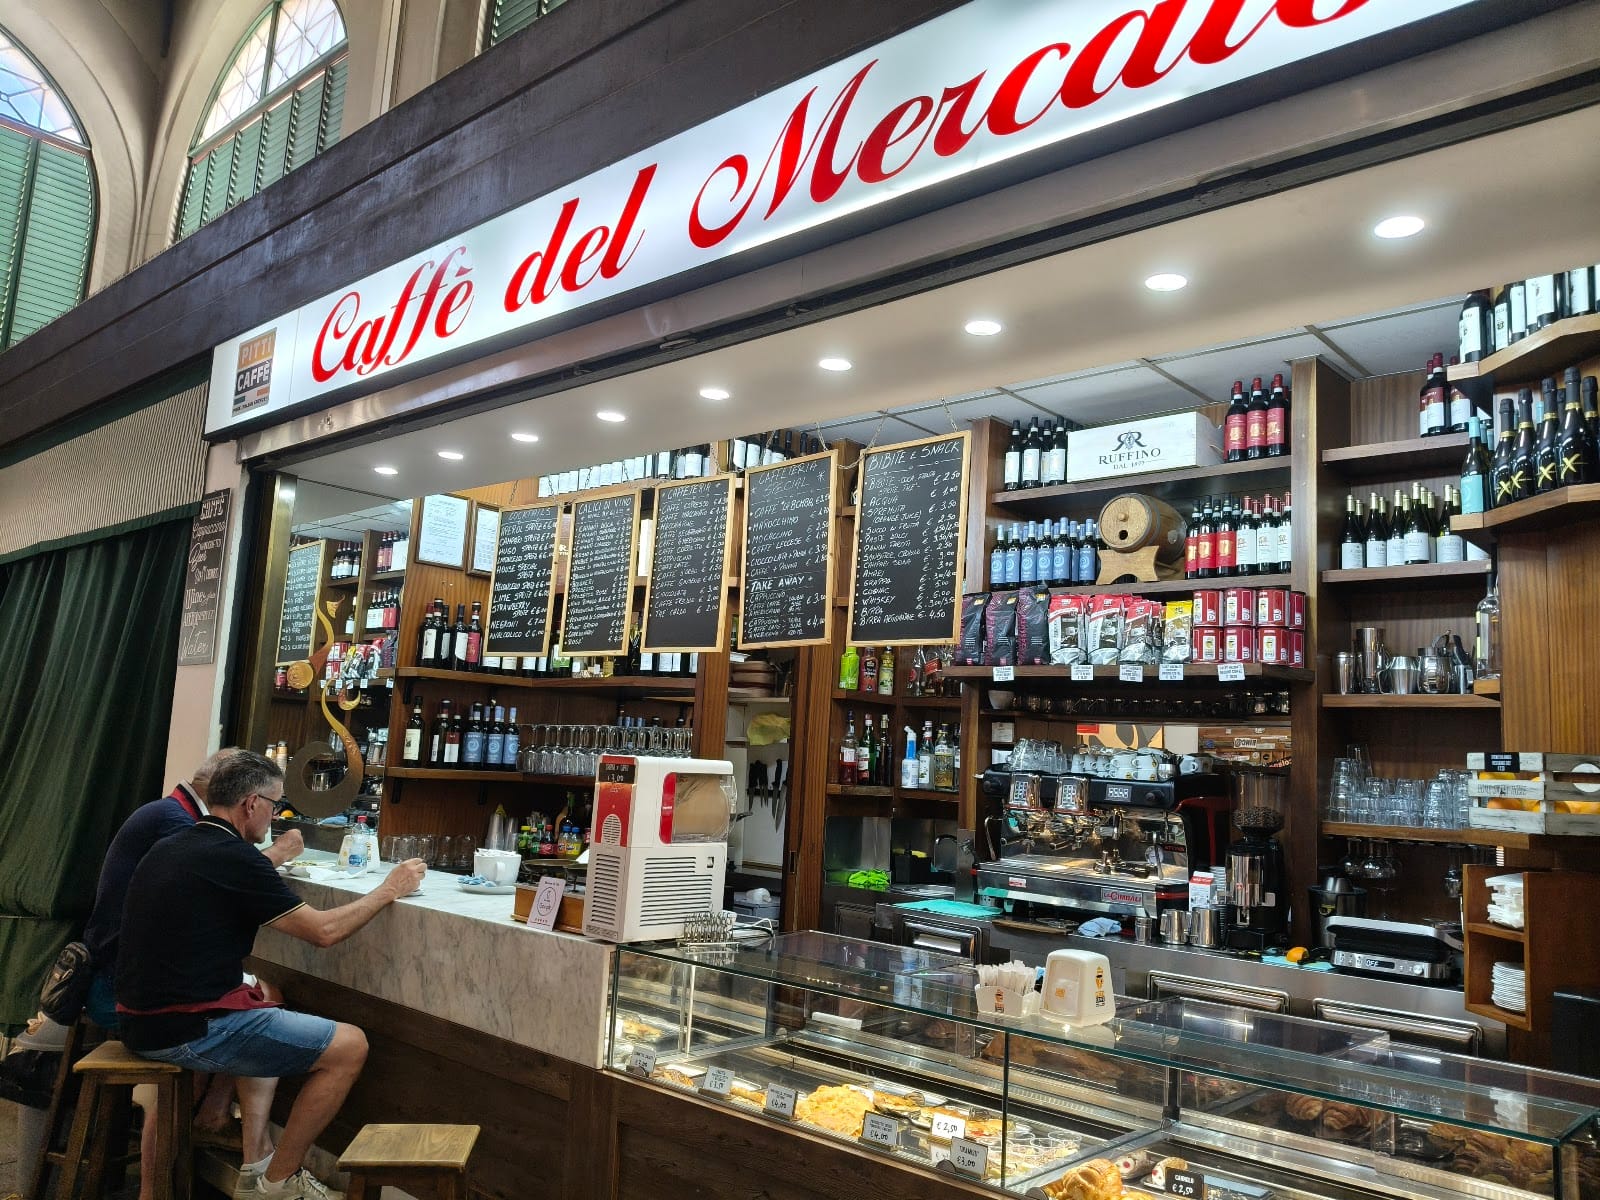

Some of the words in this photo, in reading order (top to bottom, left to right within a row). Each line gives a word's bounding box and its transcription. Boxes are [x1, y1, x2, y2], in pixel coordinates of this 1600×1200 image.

[312, 246, 474, 383] Caffè
[504, 163, 657, 313] del
[688, 0, 1368, 249] Merca
[242, 336, 272, 364] PITTI
[237, 361, 270, 391] CAFFÈ
[867, 450, 906, 472] BIBITE
[920, 441, 960, 458] SNACK
[1099, 448, 1161, 465] RUFFINO
[579, 501, 601, 514] CALICI
[615, 497, 632, 507] VINO
[869, 496, 898, 507] ACQUA
[509, 507, 551, 520] COCKTAILS
[867, 504, 906, 517] SPREMUTA
[501, 525, 523, 536] APEROL
[499, 547, 517, 555] HUGO
[497, 565, 516, 573] HOUSE
[751, 580, 774, 592] TAKE
[778, 576, 805, 587] AWAY
[863, 578, 891, 587] GRAPPA
[493, 593, 511, 603] LIME
[862, 595, 896, 606] WHISKEY
[491, 601, 531, 613] STRAWBERRY
[861, 607, 883, 617] BIRRA
[491, 620, 519, 629] NEGRONI
[860, 616, 881, 626] BIRRA
[1366, 959, 1379, 967] OFF
[1172, 1184, 1177, 1192] €
[1178, 1185, 1193, 1195] 2,50
